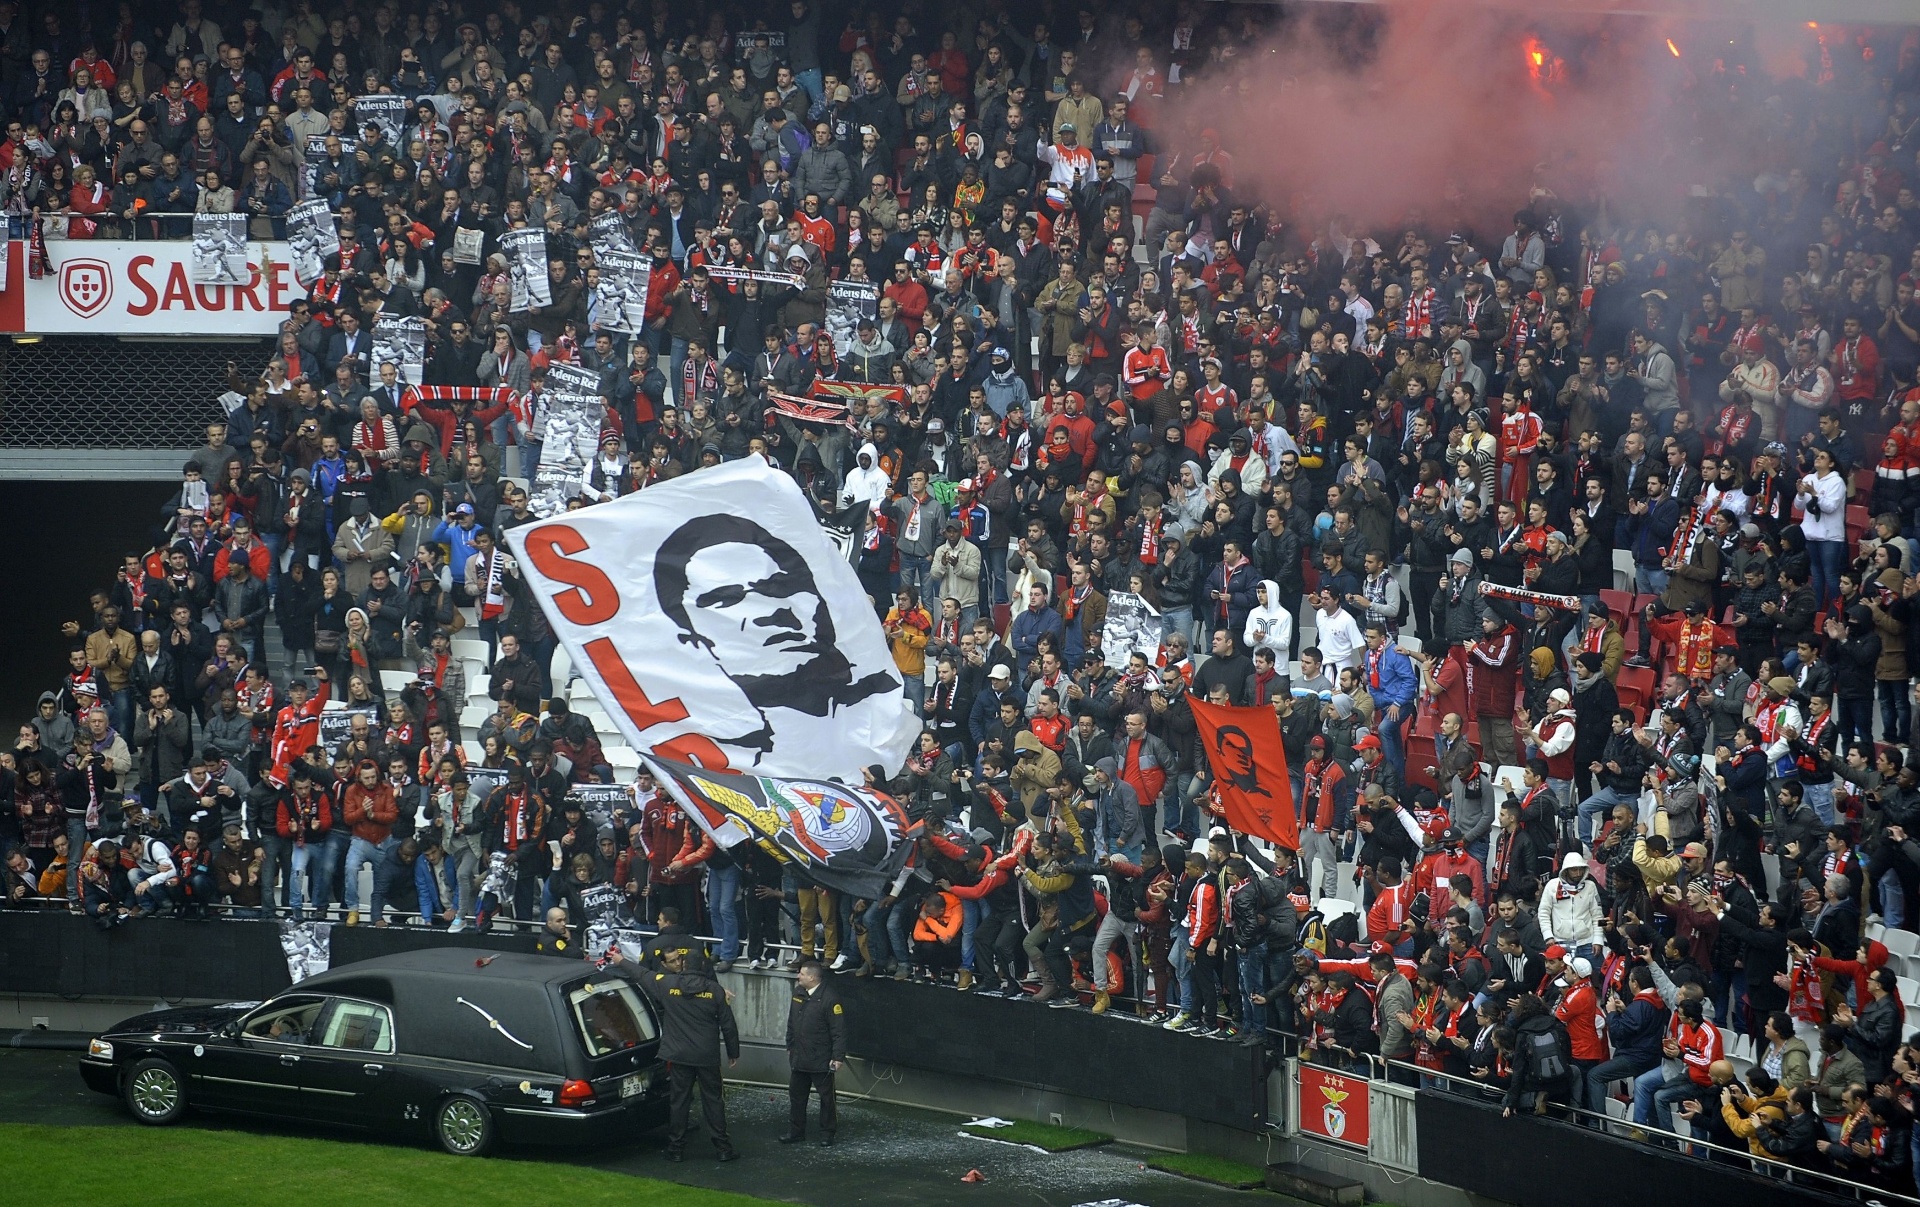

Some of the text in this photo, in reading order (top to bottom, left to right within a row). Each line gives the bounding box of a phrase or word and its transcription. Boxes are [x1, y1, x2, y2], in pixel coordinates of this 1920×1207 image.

[388, 99, 406, 110] Rei
[311, 203, 330, 217] Rei
[526, 232, 545, 244] Rei
[633, 260, 650, 271] Rei
[580, 376, 599, 390] Rei
[321, 717, 351, 729] Adeu
[580, 791, 609, 802] deus
